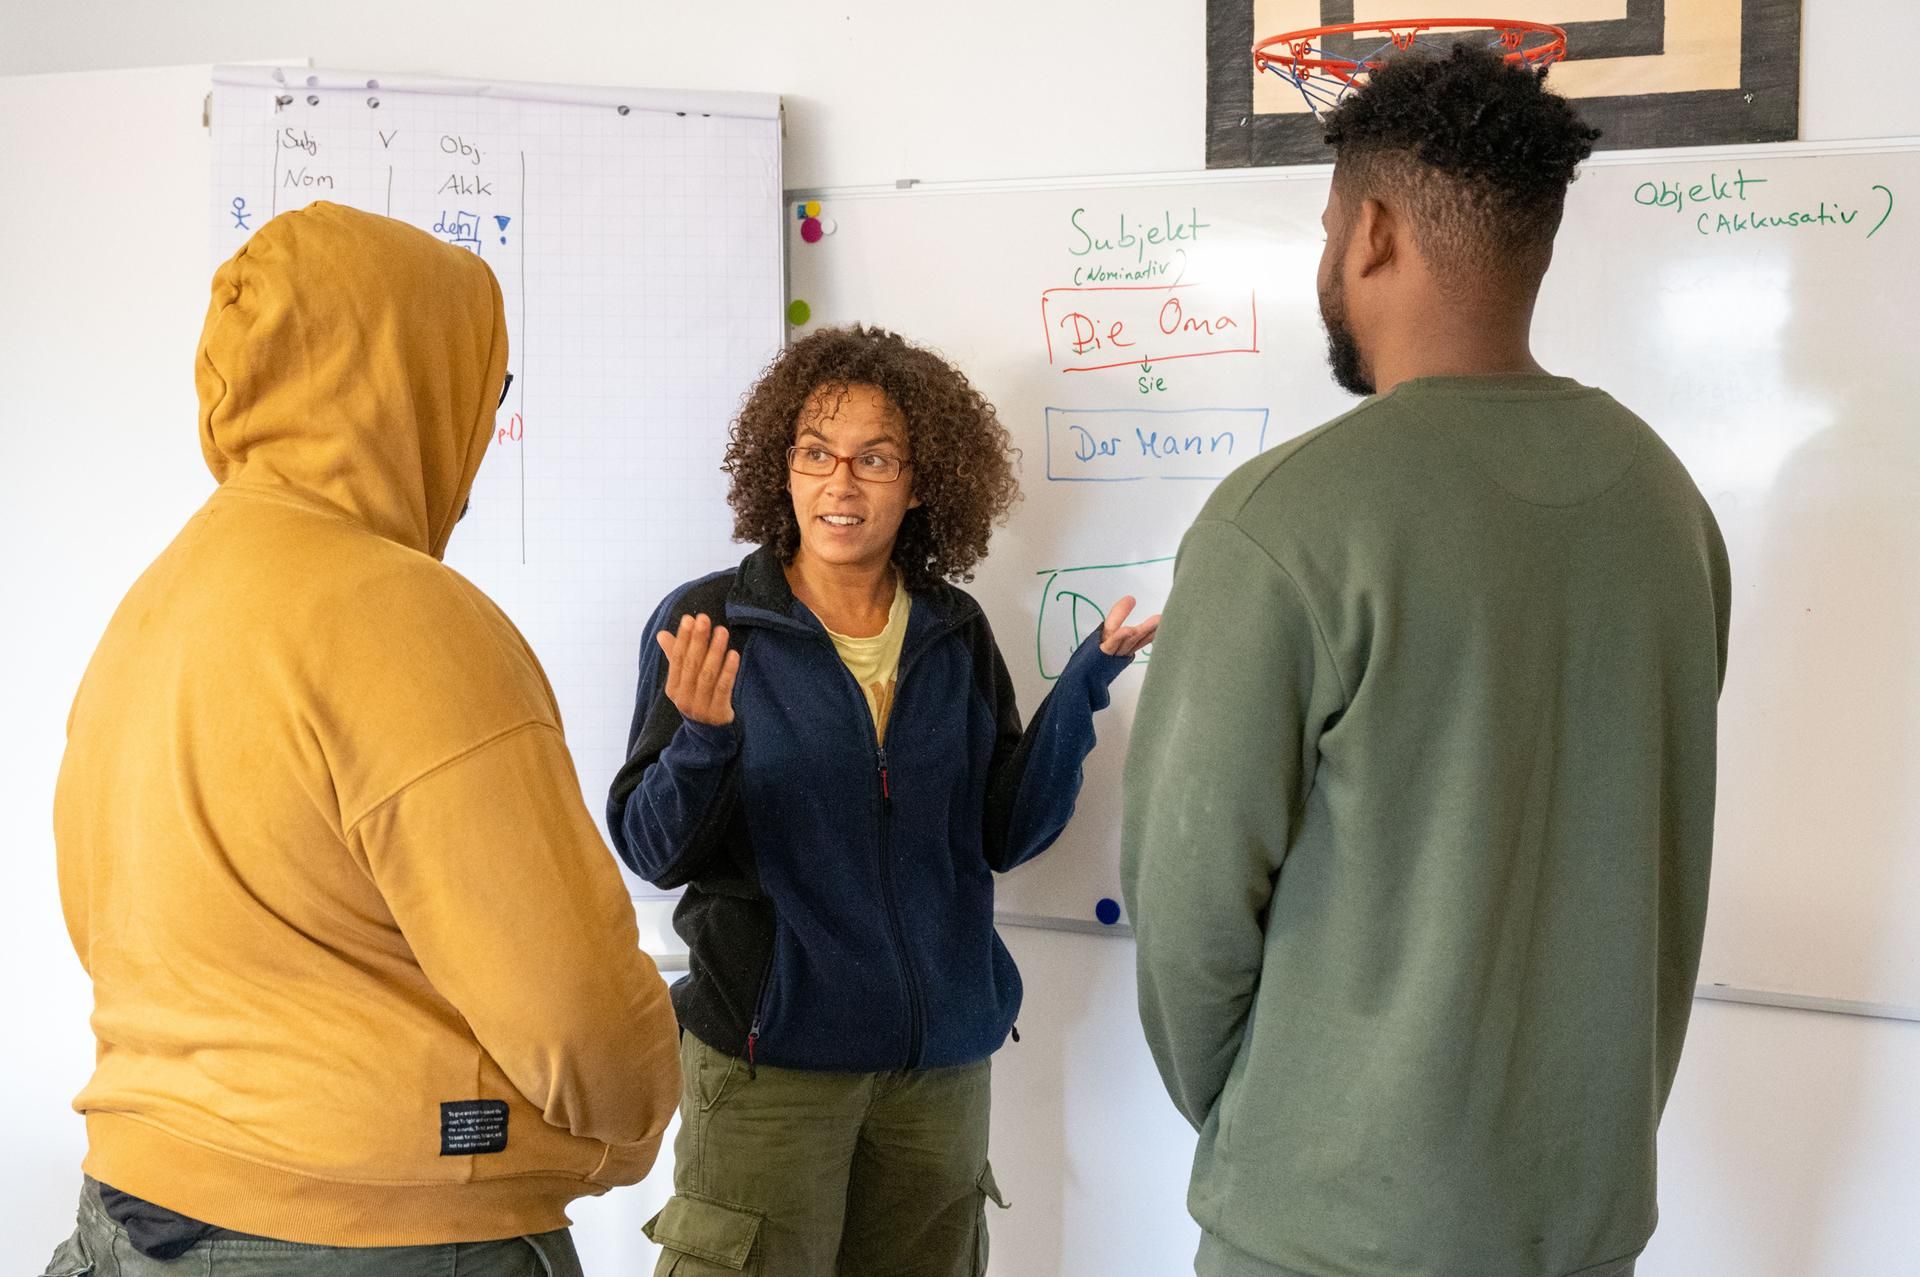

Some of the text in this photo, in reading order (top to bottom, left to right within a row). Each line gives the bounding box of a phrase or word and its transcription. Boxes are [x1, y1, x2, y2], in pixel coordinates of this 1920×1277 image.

[379, 130, 398, 149] V
[284, 166, 492, 196] Nom Akk
[1634, 168, 1768, 214] Objekt
[1068, 206, 1212, 264] Subjekt
[1060, 297, 1239, 356] Die Oma
[1069, 425, 1235, 463] Der Mann
